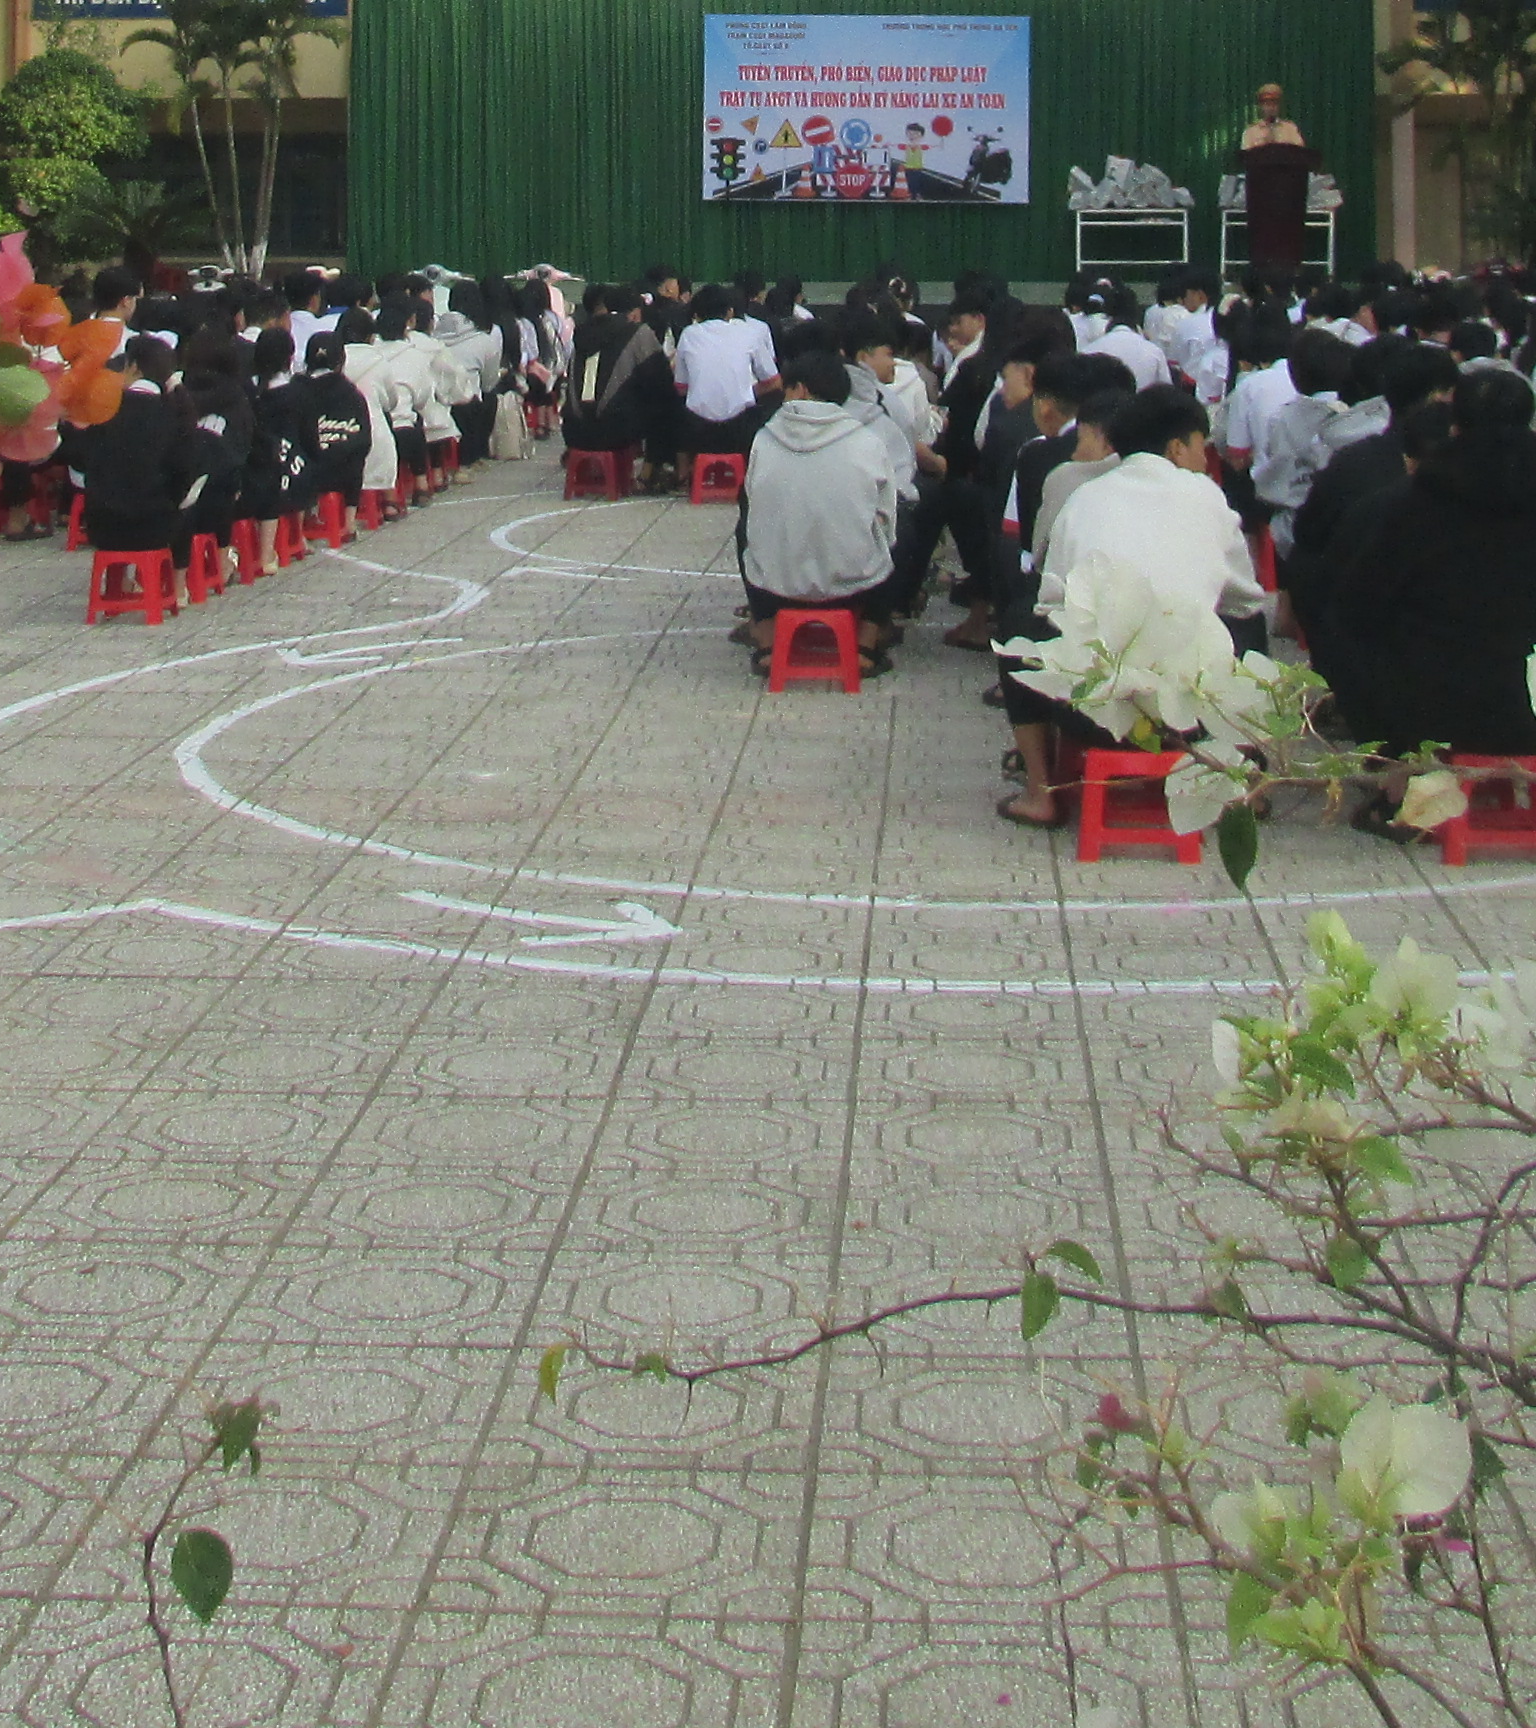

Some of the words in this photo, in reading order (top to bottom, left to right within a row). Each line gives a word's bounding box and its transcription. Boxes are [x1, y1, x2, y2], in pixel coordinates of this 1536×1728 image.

[906, 66, 927, 86] DỤC
[765, 92, 792, 107] ATGT
[941, 92, 957, 108] XE
[960, 92, 975, 108] AN
[839, 173, 866, 187] STOP
